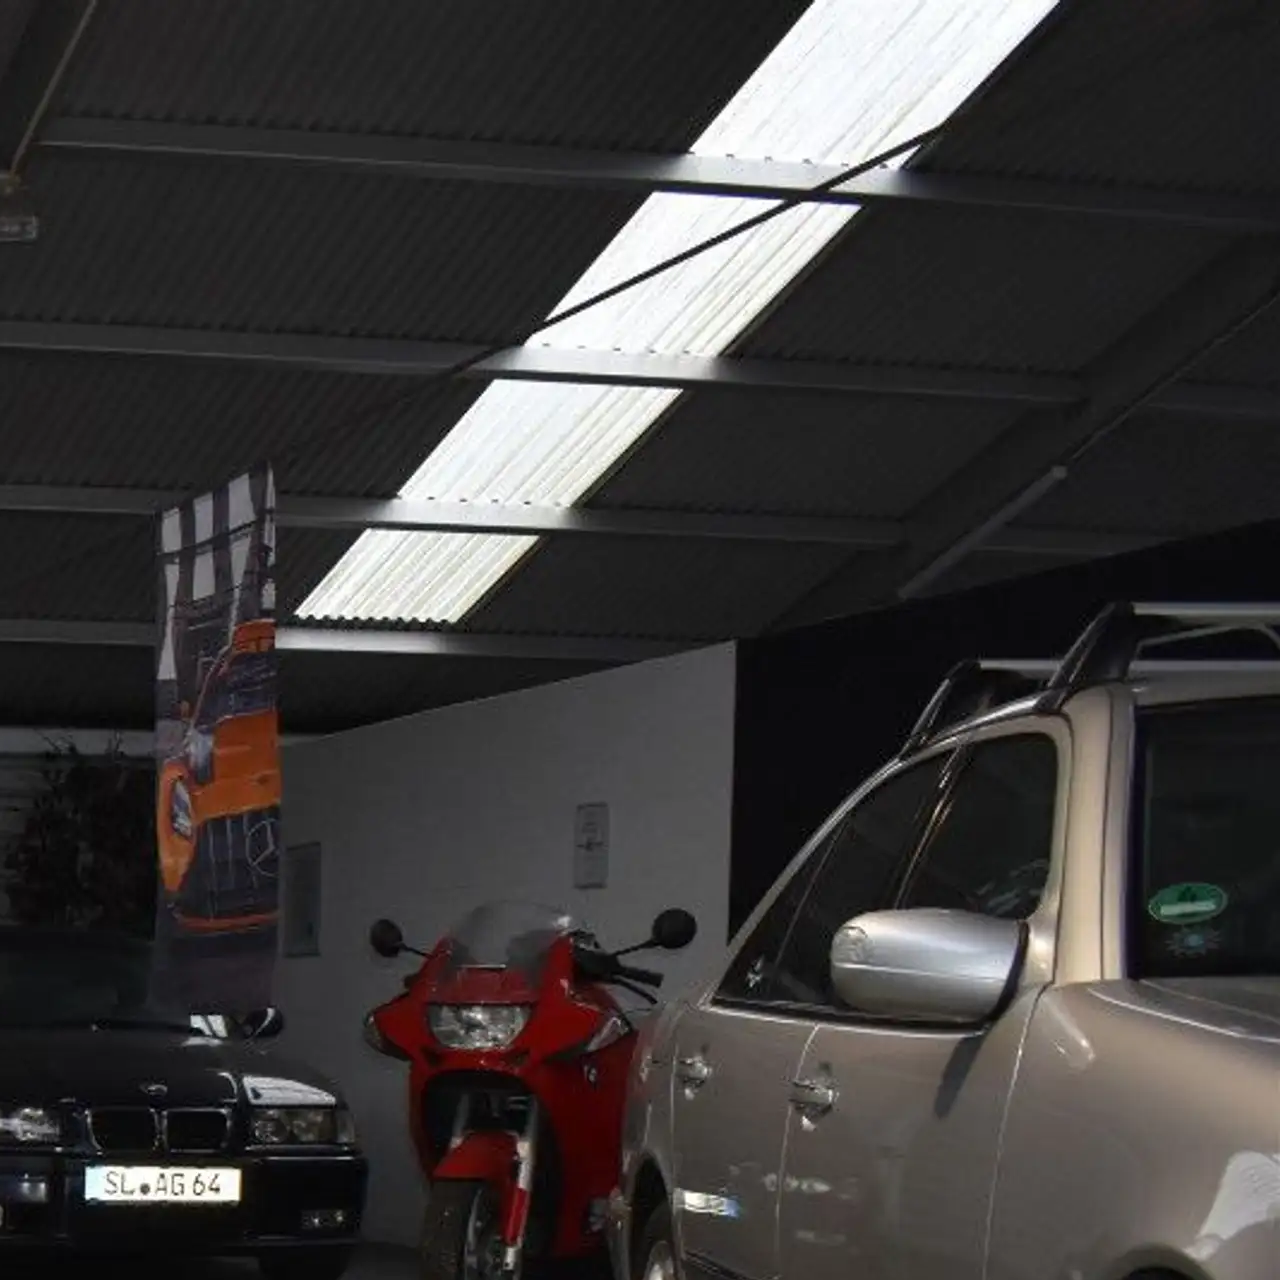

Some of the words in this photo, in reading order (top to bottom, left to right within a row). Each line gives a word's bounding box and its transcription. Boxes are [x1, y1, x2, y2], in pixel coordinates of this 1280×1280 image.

[104, 1170, 136, 1196] SL
[154, 1172, 186, 1197] AG
[192, 1172, 221, 1197] 64
